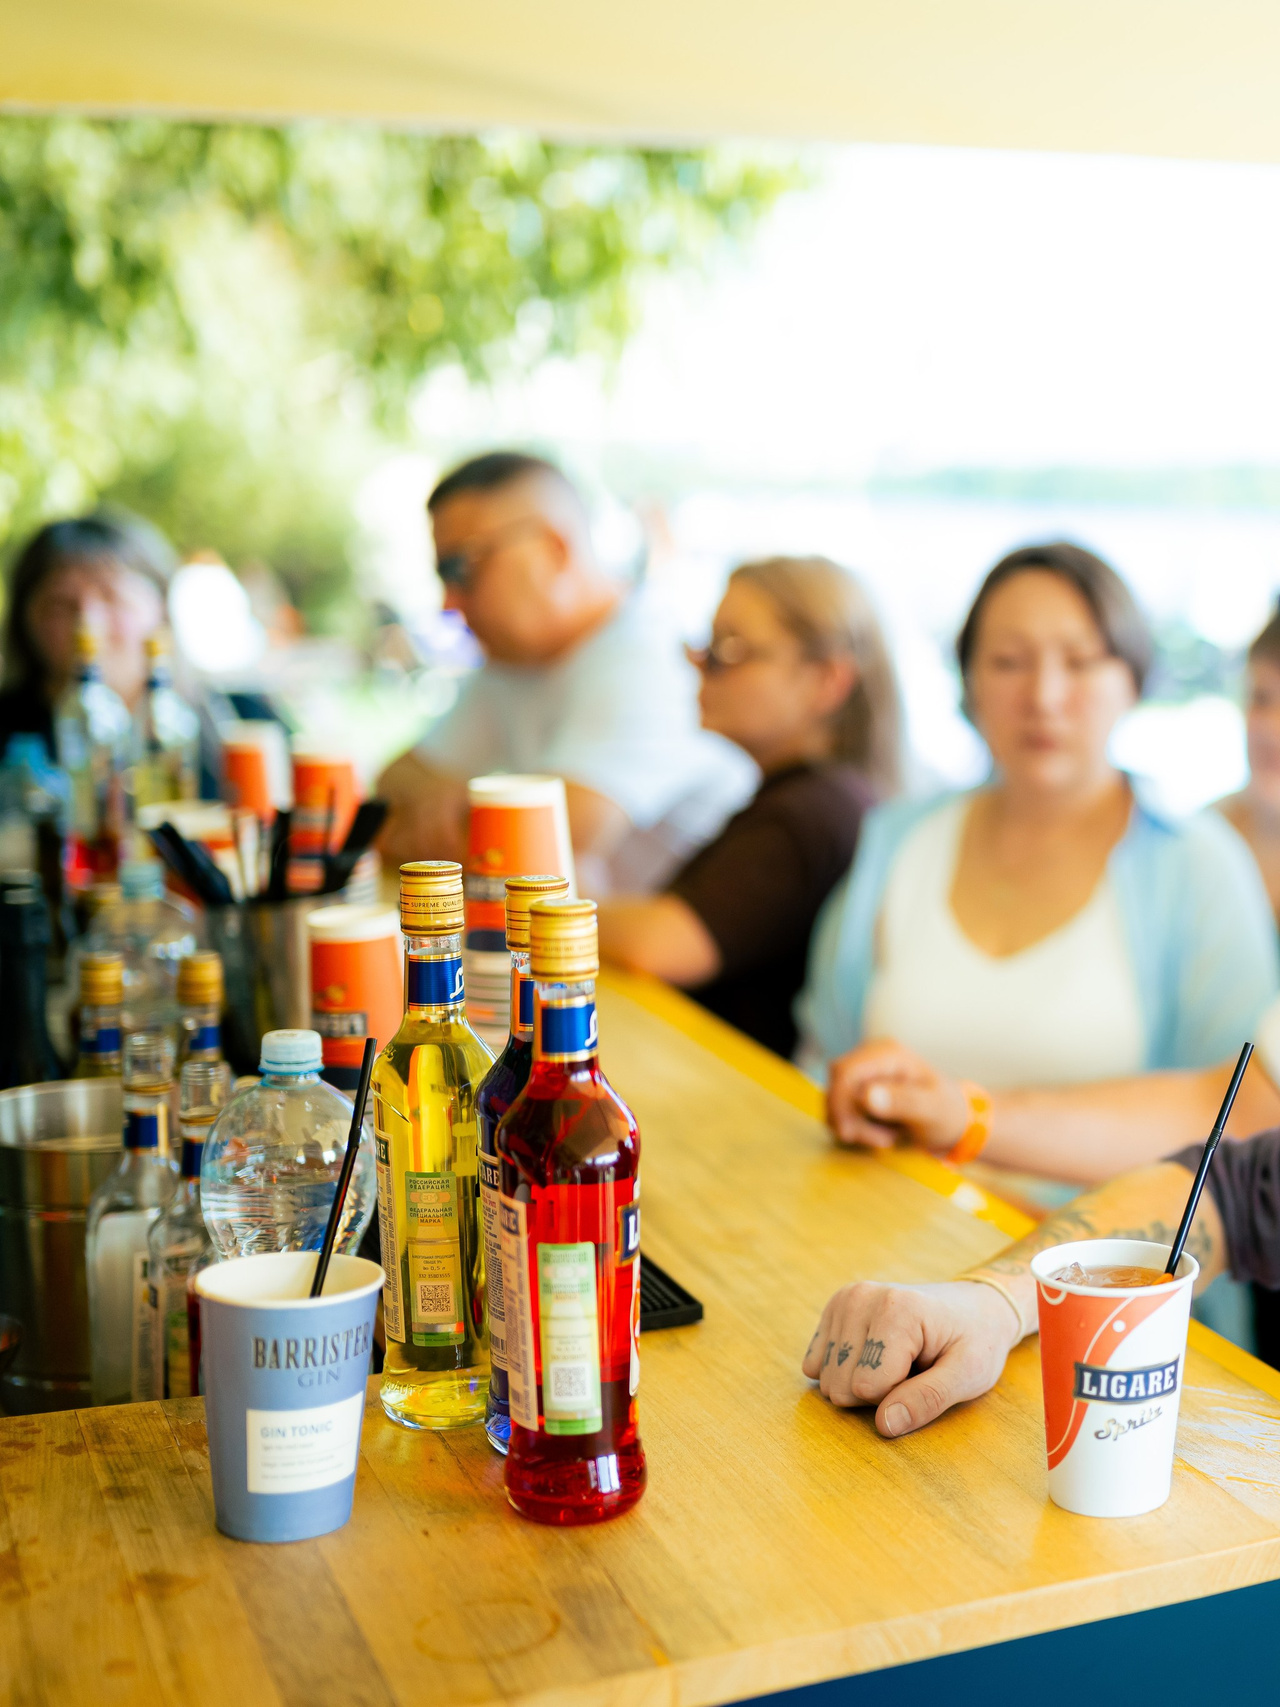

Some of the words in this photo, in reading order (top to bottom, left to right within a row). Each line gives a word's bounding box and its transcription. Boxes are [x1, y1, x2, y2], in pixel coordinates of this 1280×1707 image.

[252, 1322, 371, 1370] BARRISTER
[297, 1367, 342, 1389] GIN
[1082, 1364, 1176, 1399] LIGARE
[260, 1426, 286, 1439] GIN
[290, 1420, 333, 1438] TONIC
[1094, 1406, 1163, 1441] Spritz
